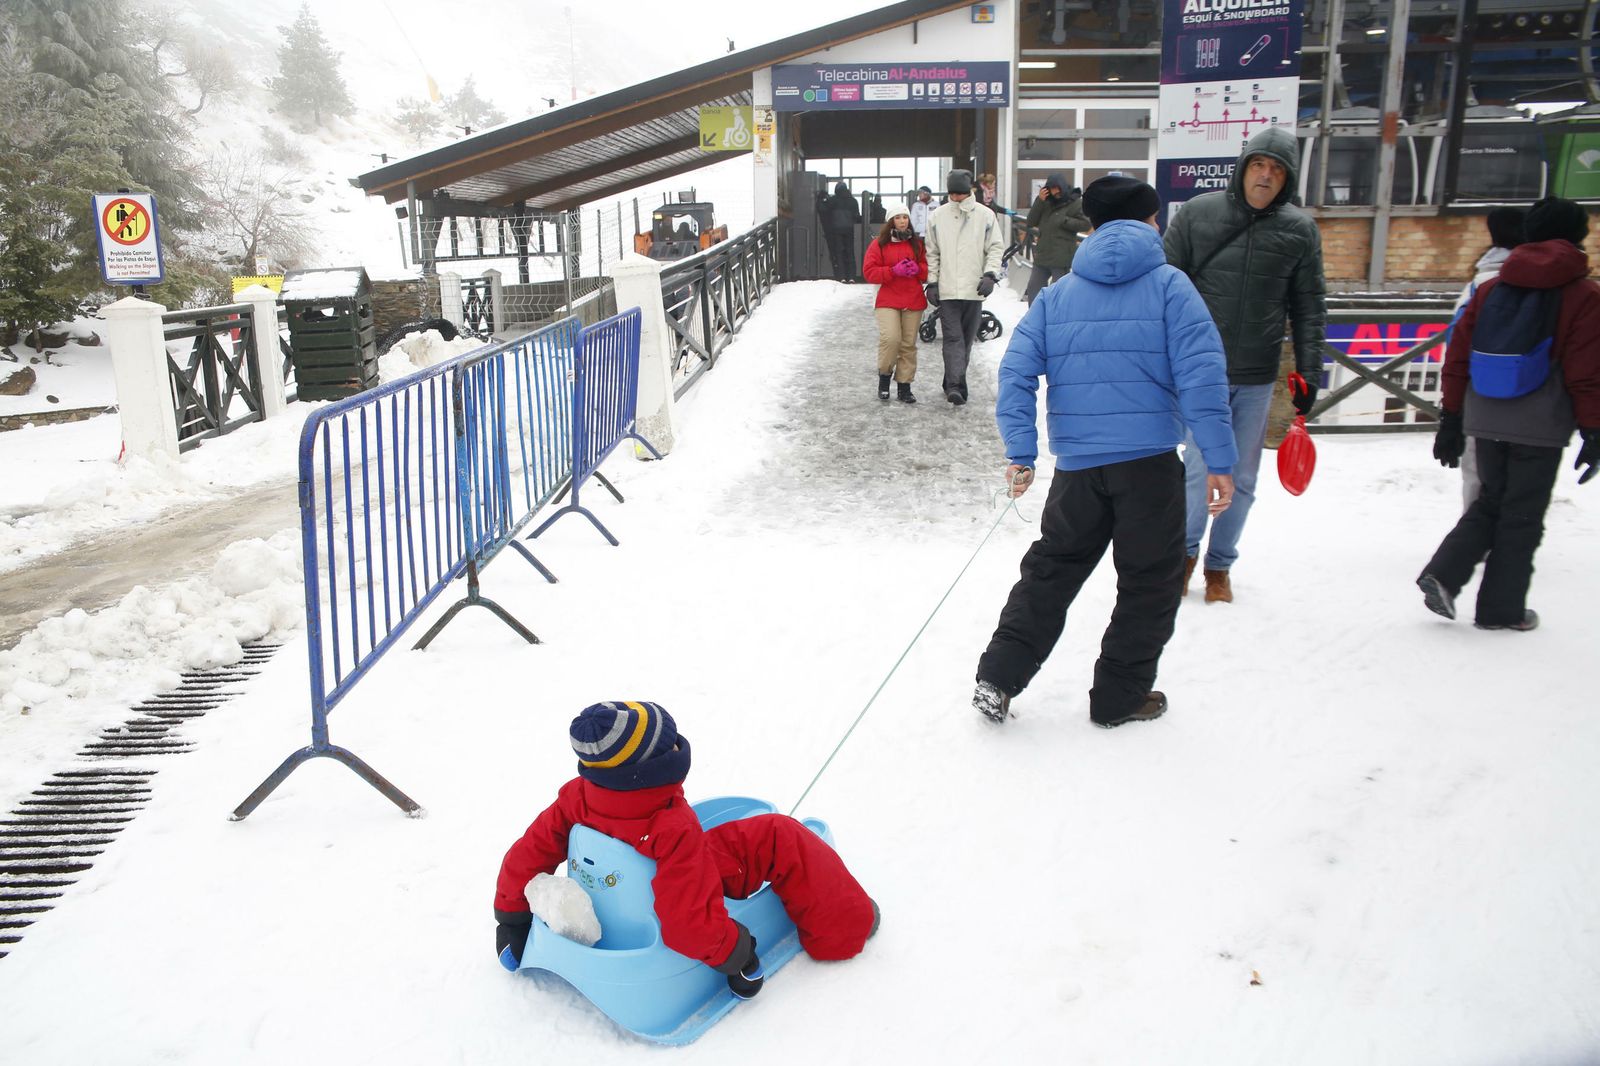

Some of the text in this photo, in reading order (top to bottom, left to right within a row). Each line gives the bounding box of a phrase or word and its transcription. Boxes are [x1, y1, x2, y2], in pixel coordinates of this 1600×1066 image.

[1183, 0, 1290, 14] ALQUI
[1183, 6, 1290, 24] ESQUÍ & SNOWBOARD
[817, 66, 967, 82] Telecabina Al-Andalus
